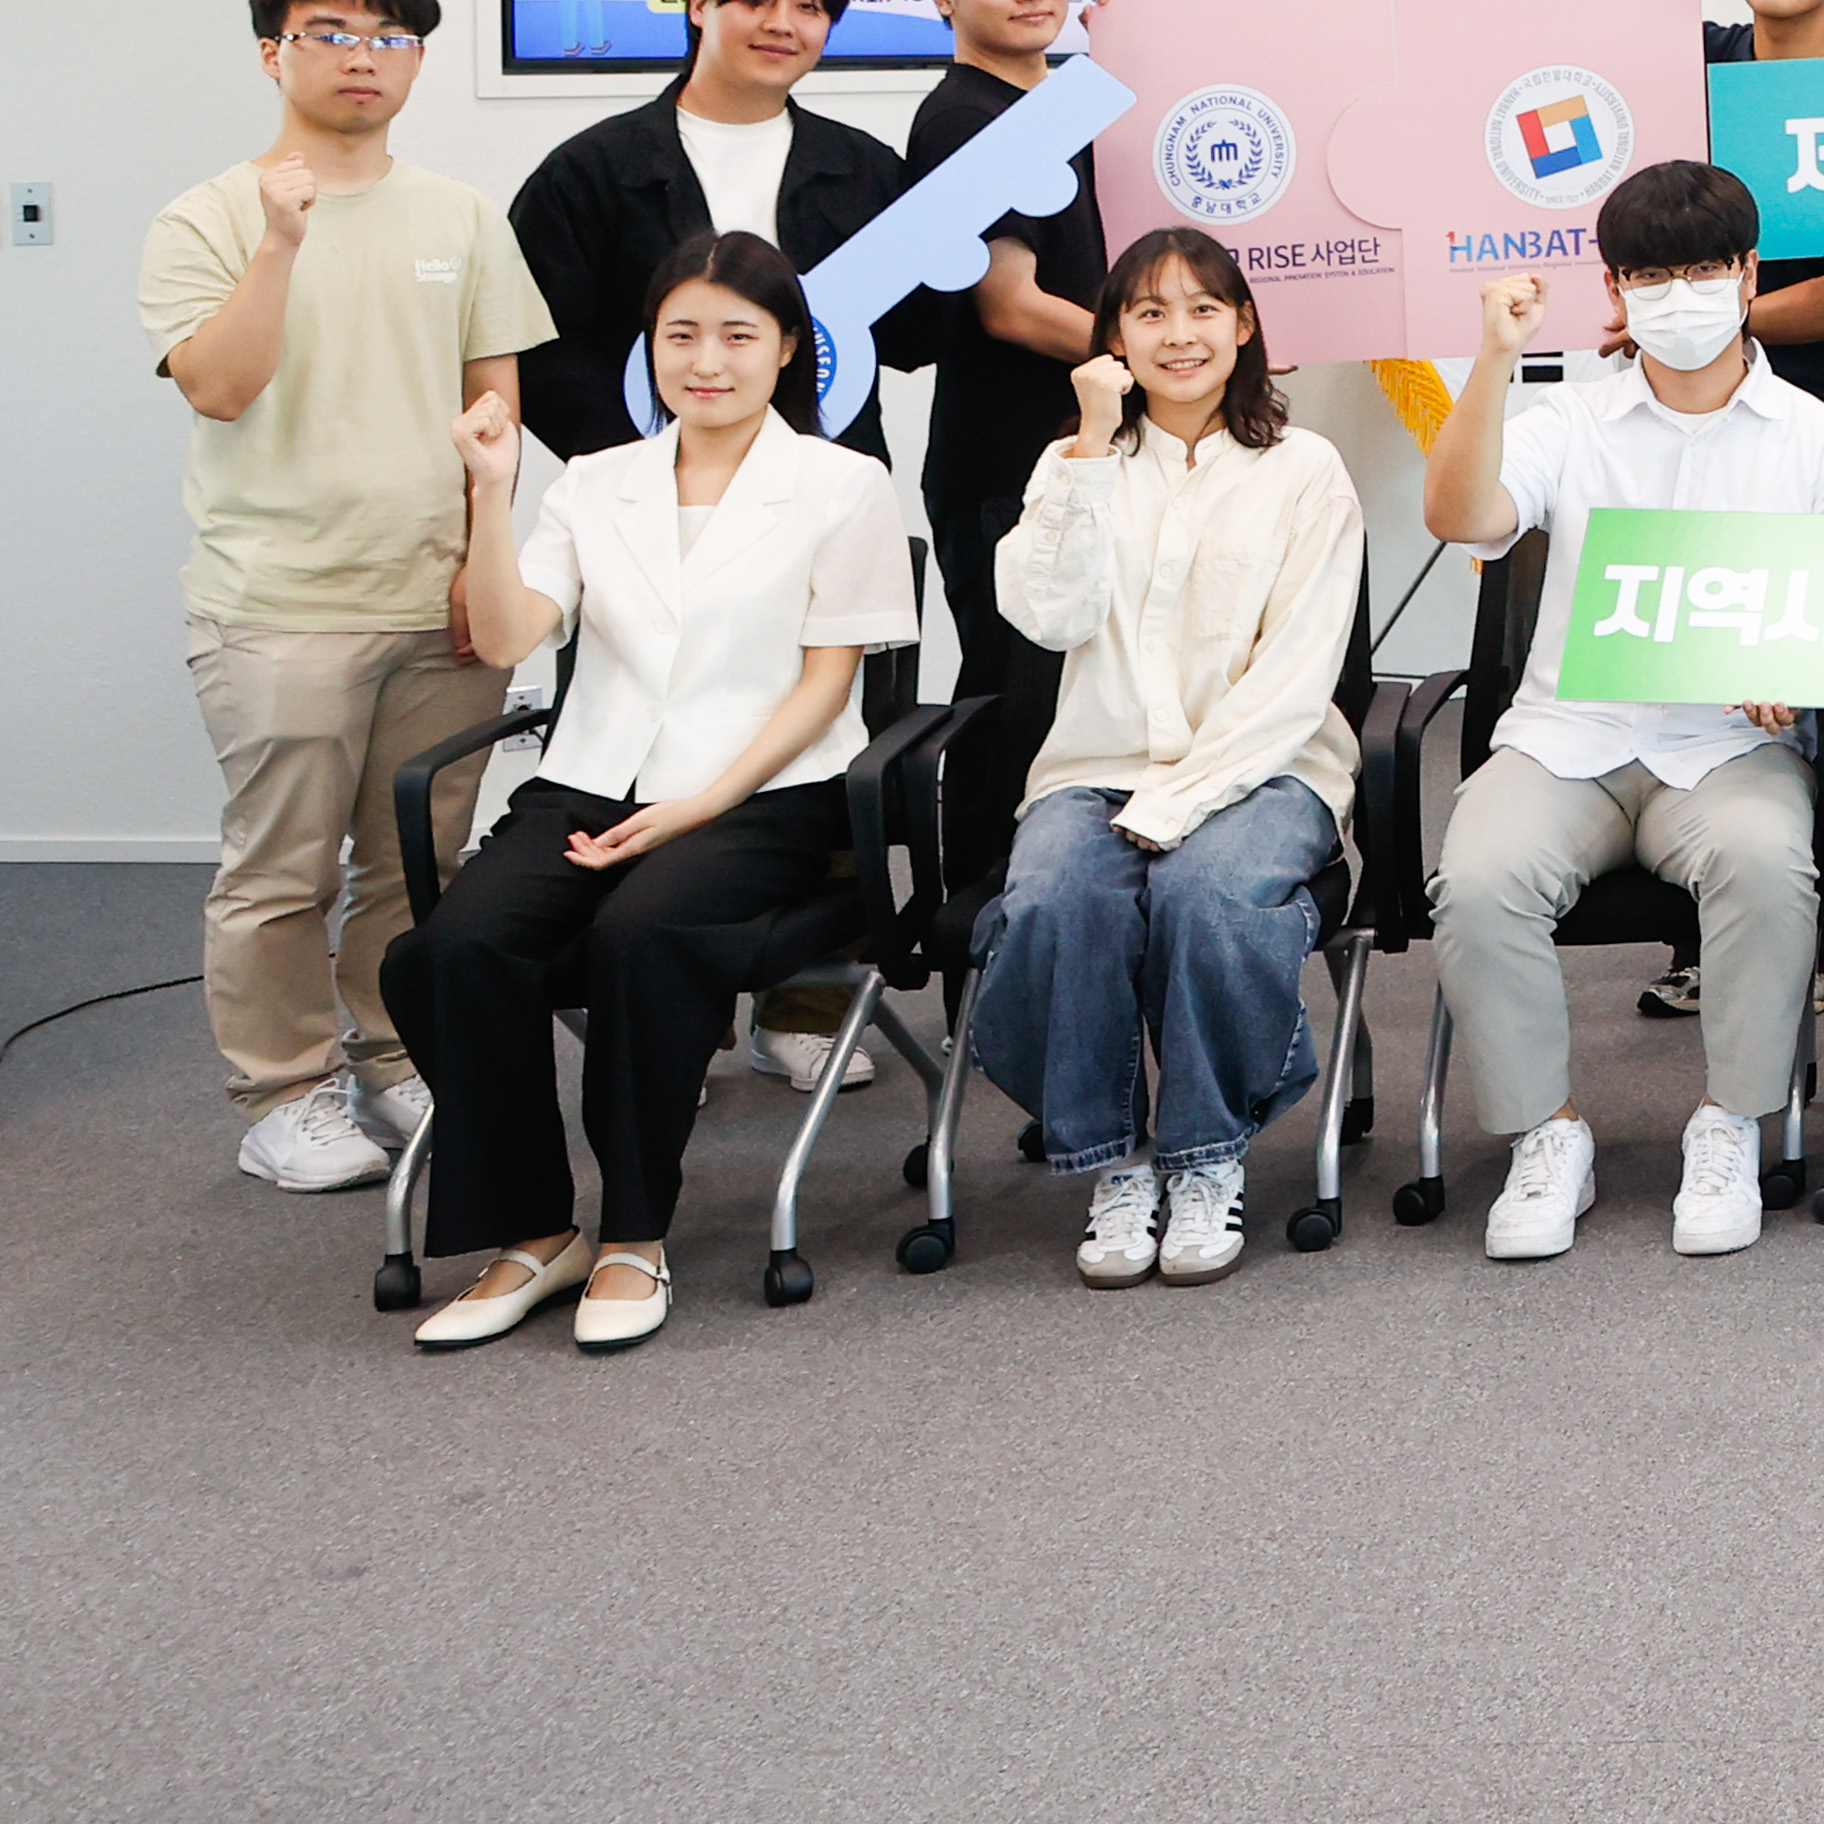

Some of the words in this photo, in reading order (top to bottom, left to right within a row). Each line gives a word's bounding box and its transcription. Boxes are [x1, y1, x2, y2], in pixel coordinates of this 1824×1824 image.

[1164, 115, 1187, 187] CHUNGNAM
[1190, 95, 1252, 114] NATIONAL
[1257, 108, 1285, 179] UNIVERSITY
[1496, 161, 1541, 201] UNIVERSITY
[1191, 192, 1262, 214] 충남대학교
[1248, 243, 1306, 271] RISE
[1311, 236, 1381, 268] 사업단
